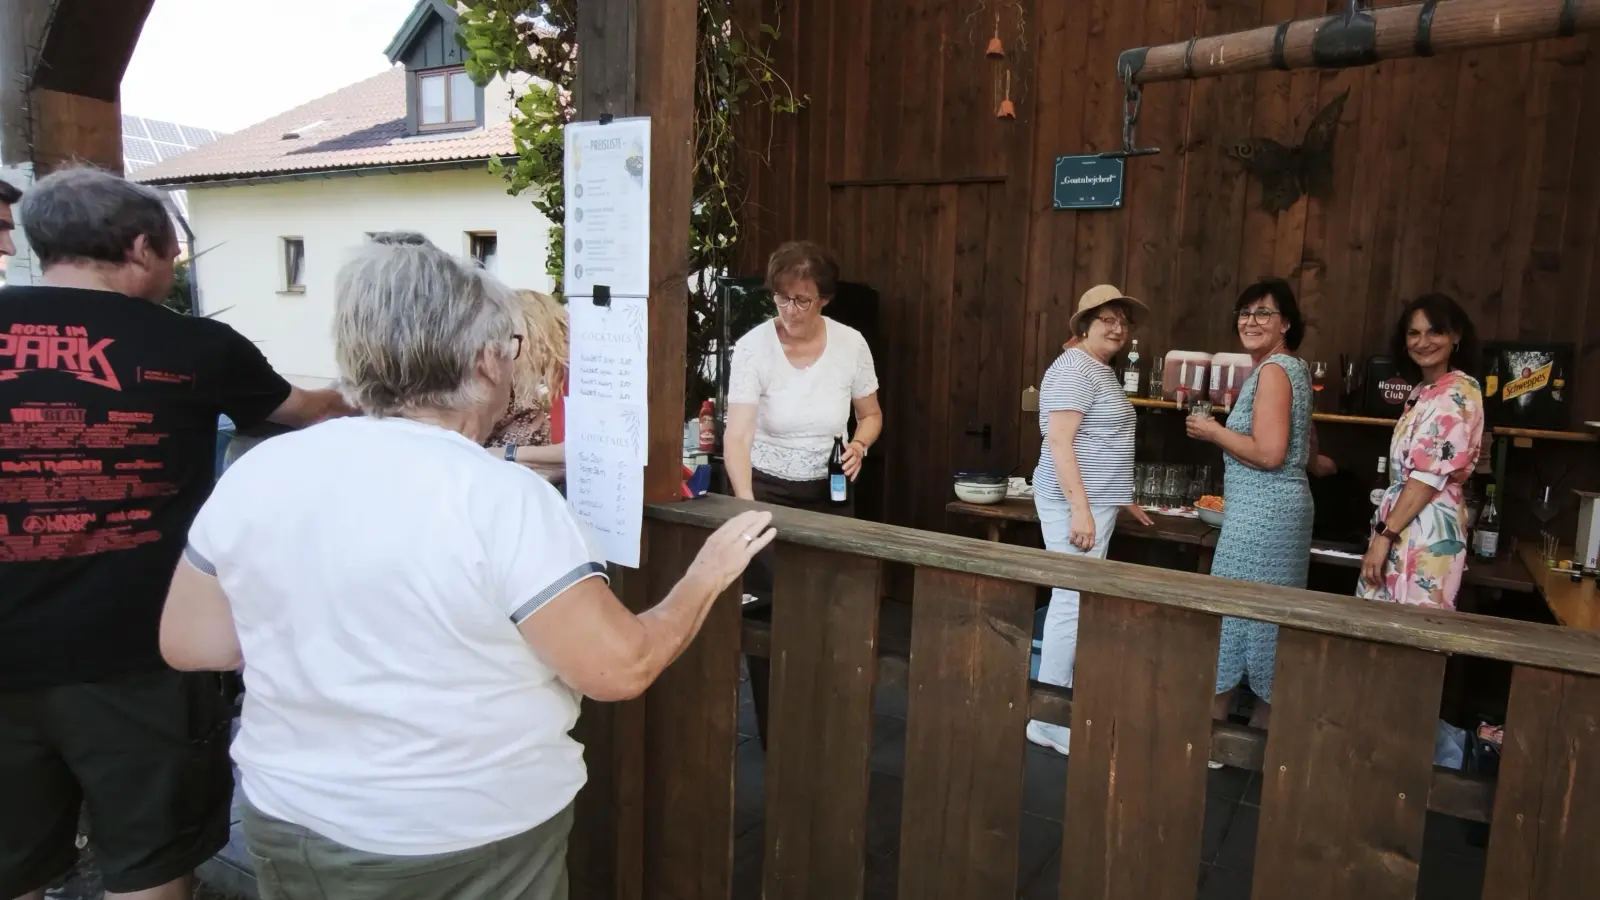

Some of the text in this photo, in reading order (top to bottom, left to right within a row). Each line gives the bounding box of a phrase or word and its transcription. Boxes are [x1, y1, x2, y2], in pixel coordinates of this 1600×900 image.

[590, 138, 622, 151] PREISLISTE
[9, 323, 88, 337] ROCK IM
[580, 331, 632, 344] COCKTAILS
[0, 333, 122, 391] PARK
[1378, 381, 1412, 391] Havana
[1506, 373, 1546, 397] Schweppes
[1384, 390, 1404, 399] Club
[581, 432, 629, 447] COCKTAILS
